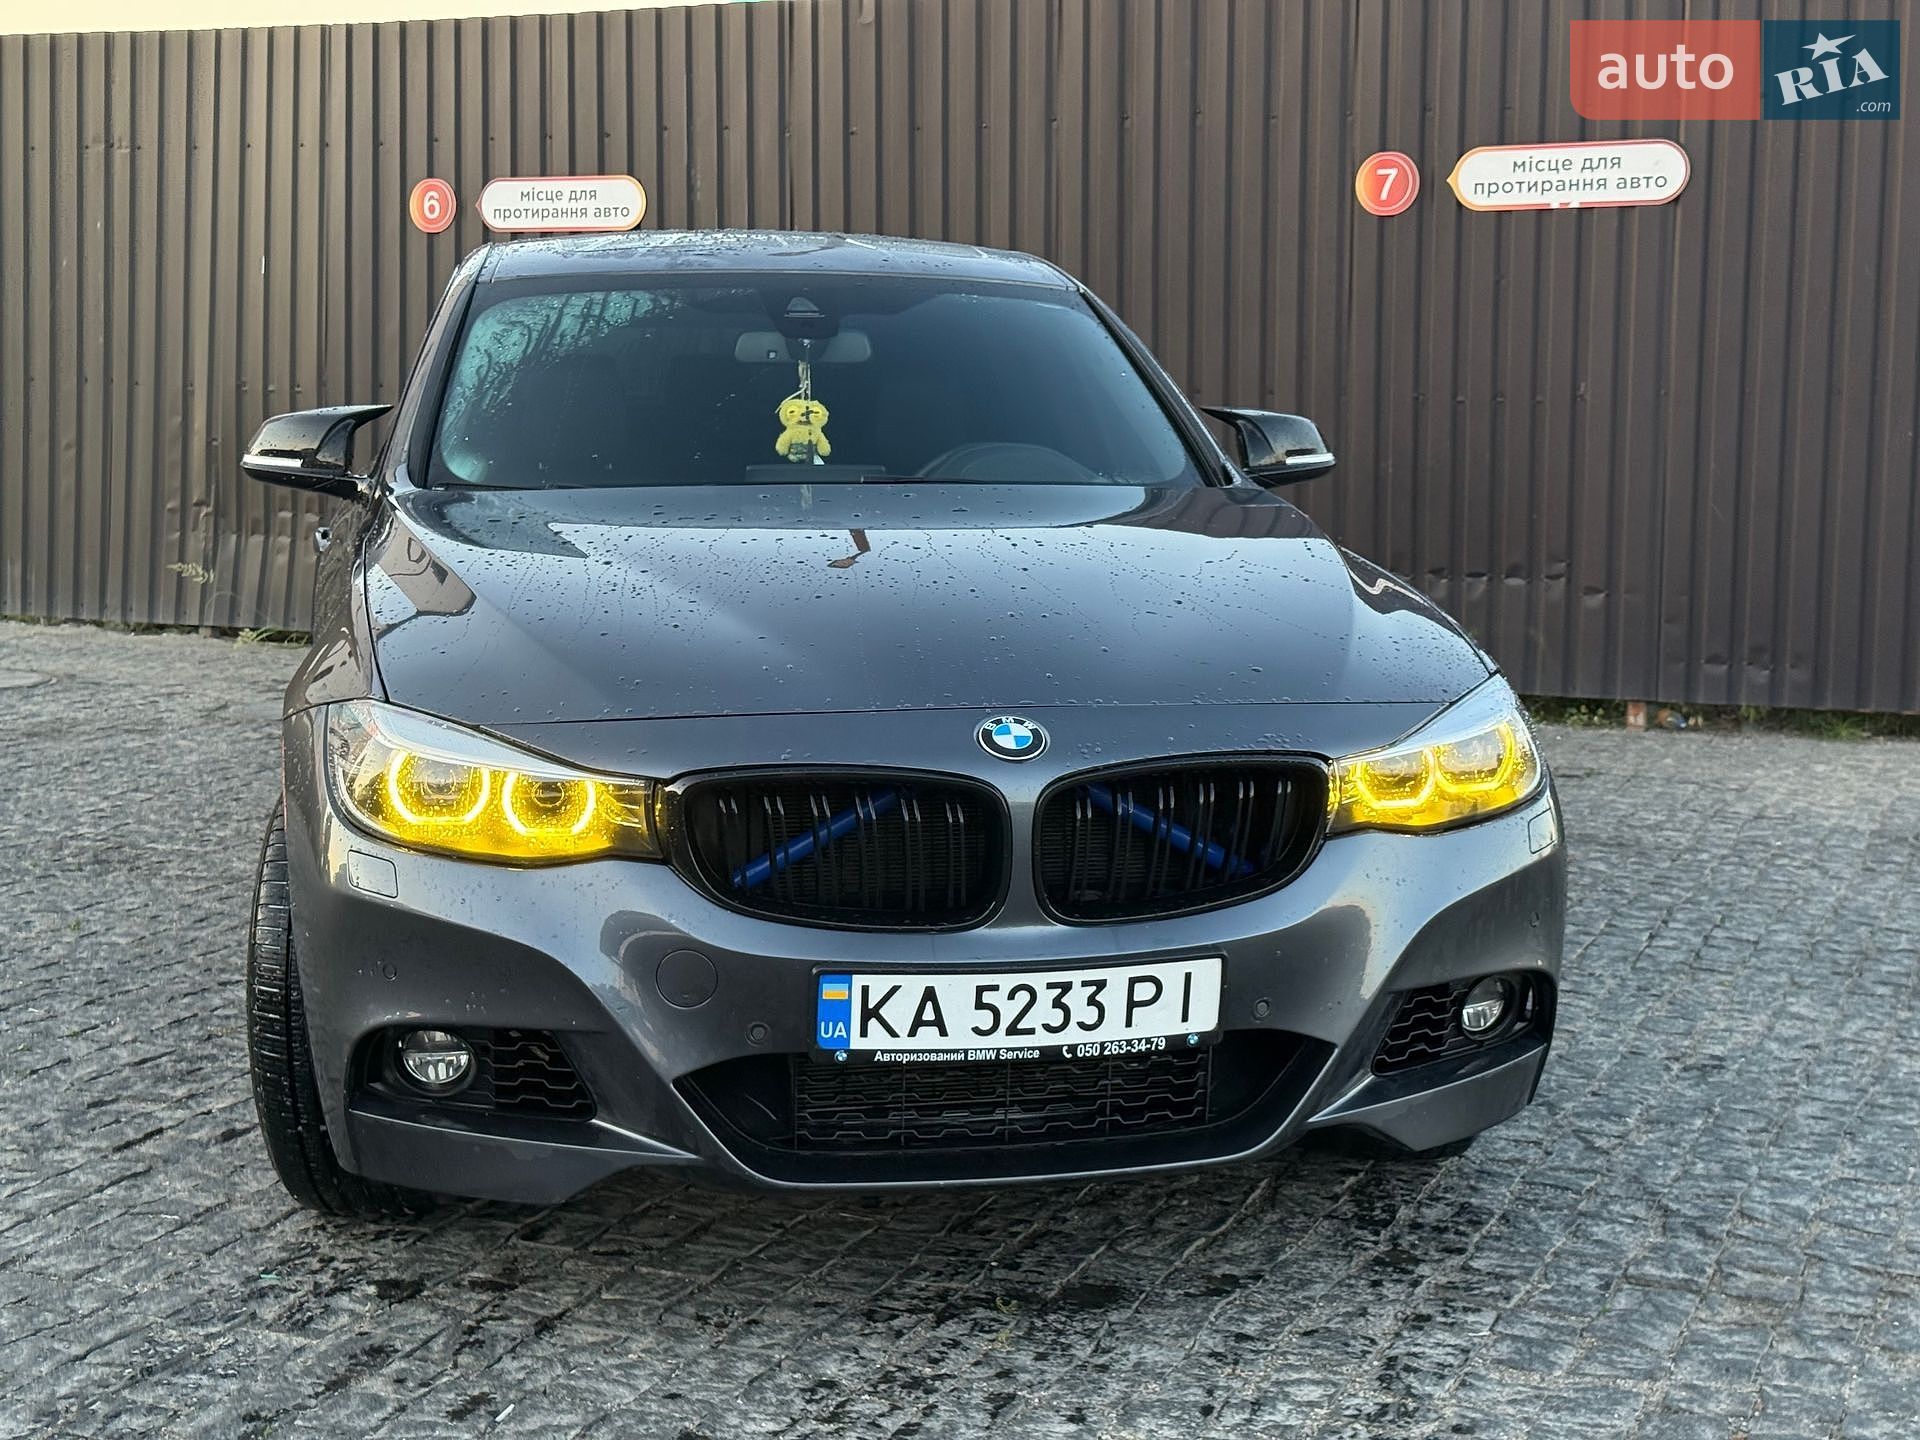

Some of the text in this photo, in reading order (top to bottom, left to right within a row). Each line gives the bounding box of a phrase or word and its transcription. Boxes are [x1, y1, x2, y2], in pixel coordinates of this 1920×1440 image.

[1512, 155, 1622, 175] місце для
[1375, 167, 1399, 201] 7
[1473, 174, 1668, 198] протирання авто
[423, 190, 441, 220] 6
[520, 187, 598, 203] місце для
[493, 205, 630, 221] протирання авто
[984, 716, 1037, 731] BMW
[859, 984, 950, 1039] KA
[971, 978, 1107, 1037] 5233
[820, 1020, 847, 1039] UA
[874, 1047, 1040, 1064] Авторизований BMW Service
[1077, 1037, 1166, 1058] 050 263-34-79
